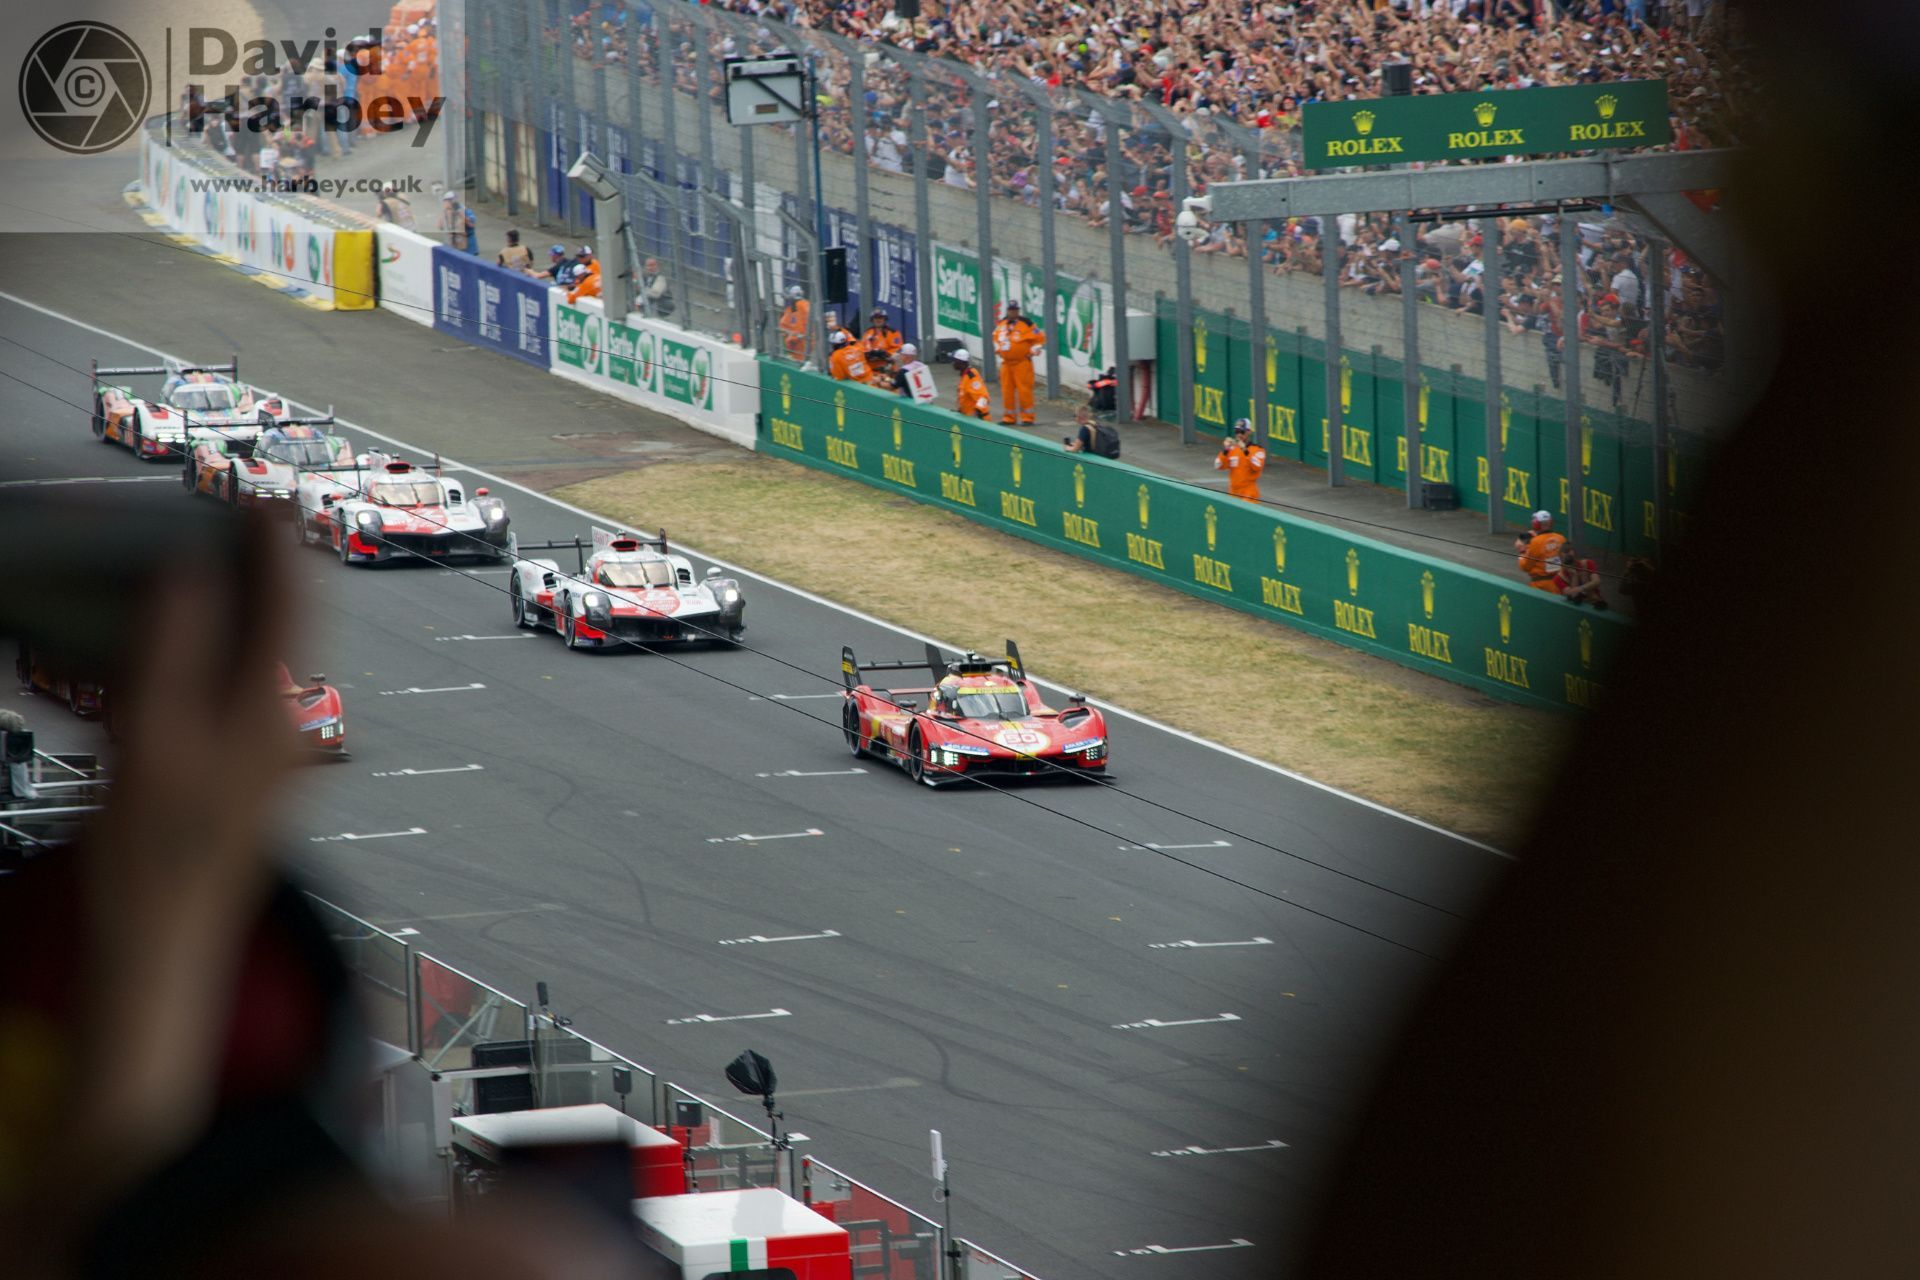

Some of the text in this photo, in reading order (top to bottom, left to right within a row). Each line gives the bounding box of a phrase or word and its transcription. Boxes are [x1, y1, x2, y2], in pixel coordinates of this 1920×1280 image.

[1327, 137, 1403, 157] ROLEX
[1448, 129, 1525, 149] ROLEX
[1569, 121, 1646, 141] ROLEX
[1194, 384, 1226, 424] LEX
[772, 418, 803, 451] ROLEX
[826, 436, 858, 469] ROLEX
[882, 454, 916, 488] ROLEX
[1397, 436, 1449, 483] RLEX
[940, 472, 976, 507] ROLEX
[1560, 478, 1612, 532] RLEX
[1001, 491, 1037, 527] ROLEX
[1062, 512, 1100, 548] ROLEX
[1126, 532, 1165, 570] ROLEX
[1193, 554, 1232, 592] ROLEX
[1261, 576, 1303, 615] ROLEX
[1334, 600, 1376, 639] ROLEX
[1408, 623, 1452, 664] ROLEX
[1485, 647, 1529, 689] ROLEX
